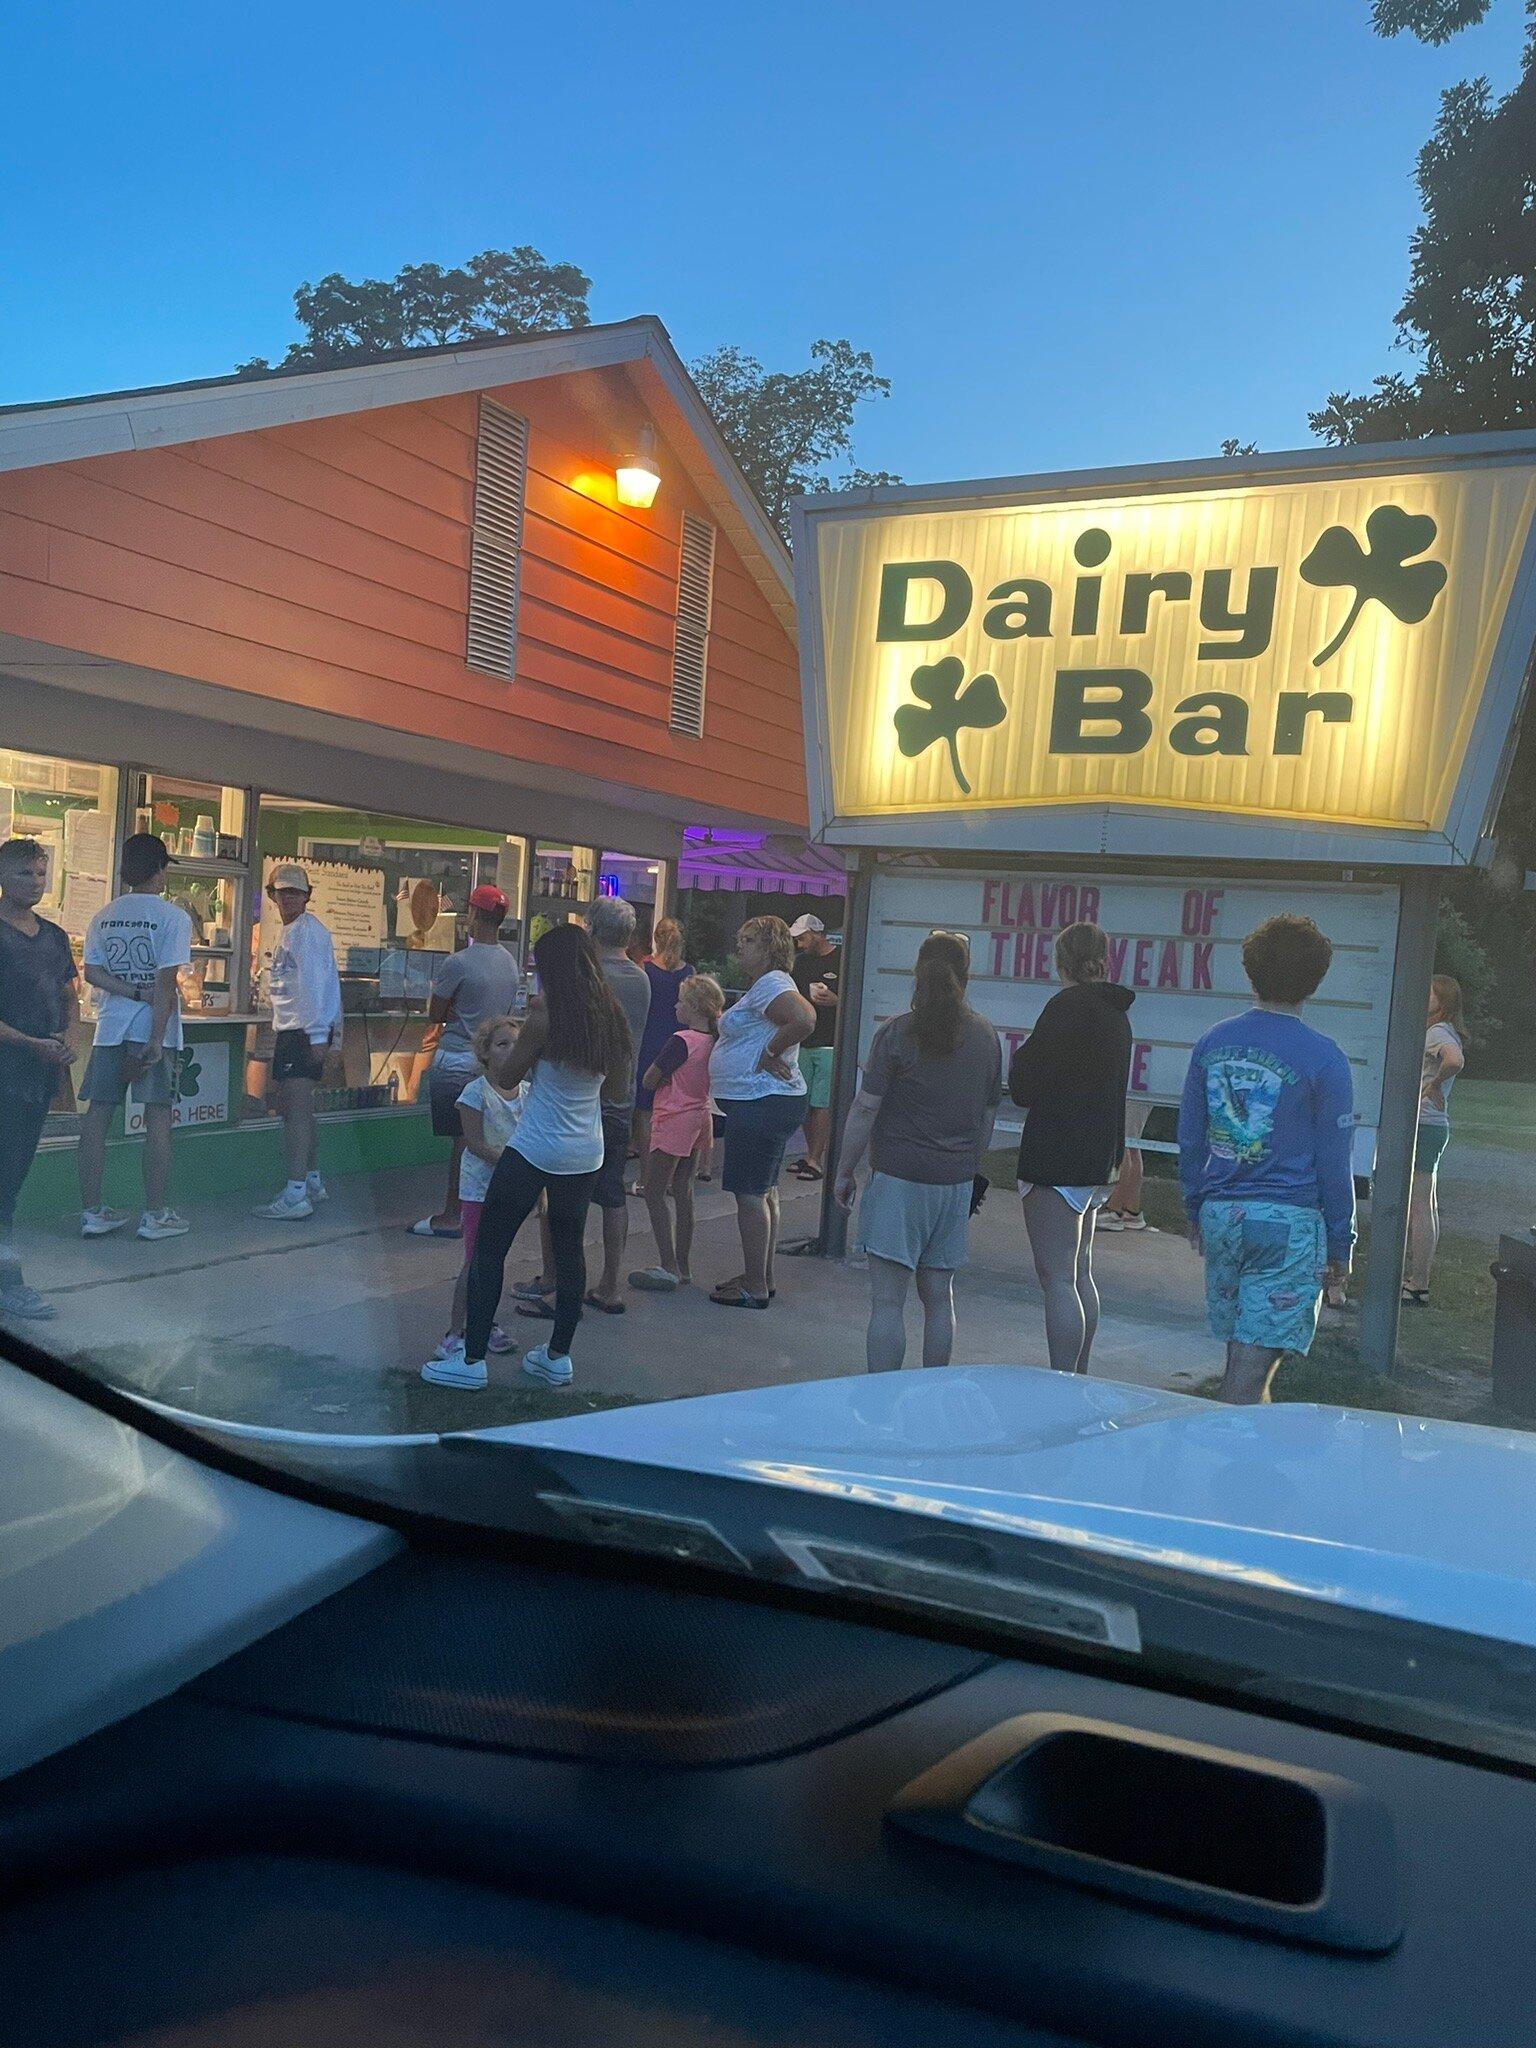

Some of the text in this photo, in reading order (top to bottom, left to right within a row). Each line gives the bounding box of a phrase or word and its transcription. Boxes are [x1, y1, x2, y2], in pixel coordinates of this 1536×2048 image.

[876, 528, 1279, 661] Dairy
[1048, 668, 1354, 756] Bar
[982, 879, 1225, 936] FLAVOR OF
[991, 931, 1053, 980] THE
[188, 1103, 225, 1122] HERE
